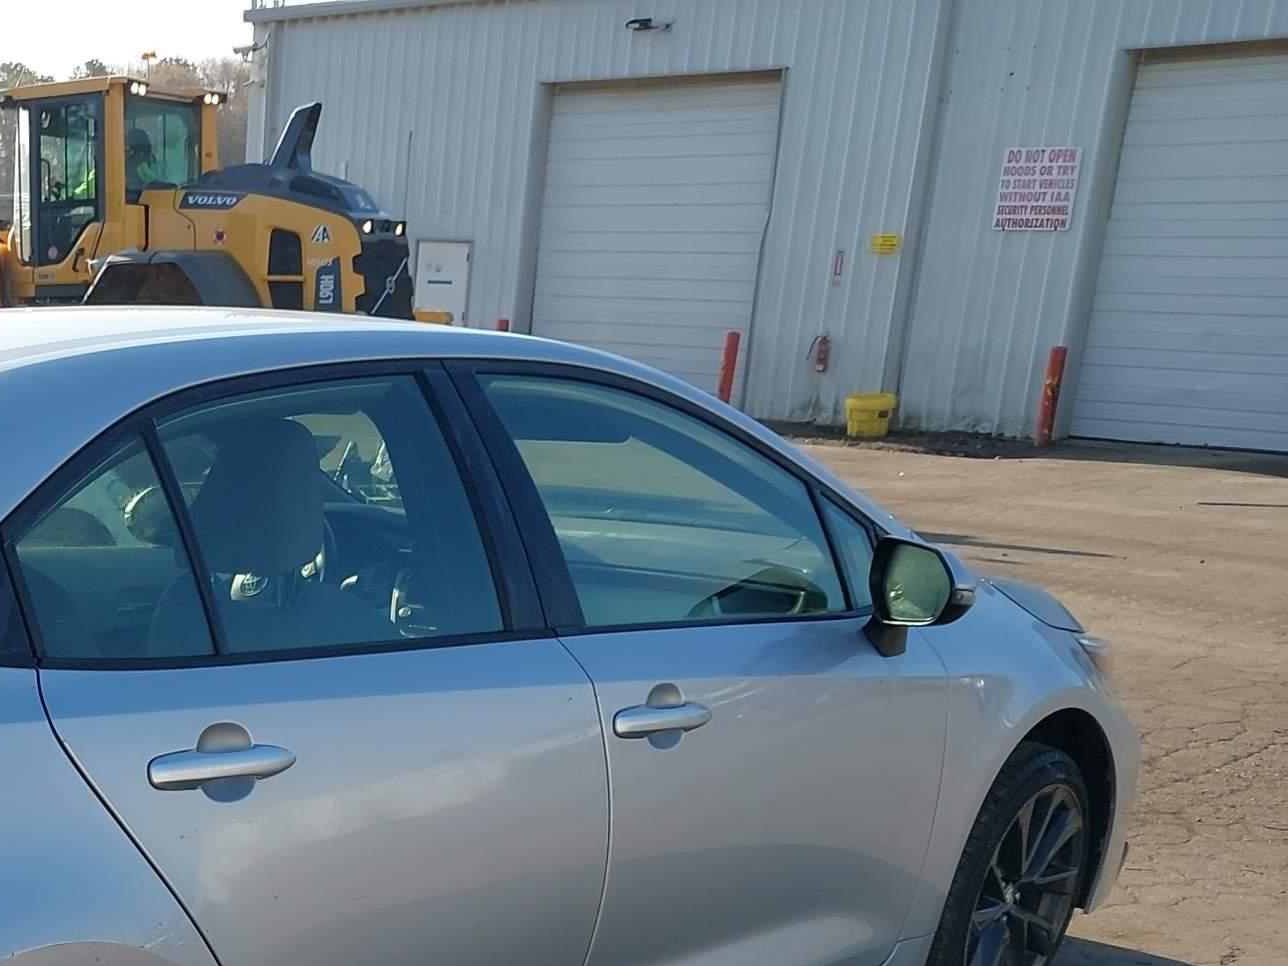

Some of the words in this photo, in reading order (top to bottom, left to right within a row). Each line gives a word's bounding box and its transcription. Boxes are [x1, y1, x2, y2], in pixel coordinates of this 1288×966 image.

[1007, 149, 1022, 163] DO
[1024, 149, 1046, 163] NOT
[1048, 148, 1077, 163] OPEN
[1003, 165, 1037, 176] HOODS
[1039, 165, 1054, 176] OR
[1056, 165, 1077, 176] TRY
[1001, 179, 1011, 190] TO
[1012, 179, 1037, 190] START
[1039, 178, 1075, 190] VEHICLES
[188, 195, 237, 206] VOLVO
[999, 191, 1048, 202] WITHOUT
[1050, 191, 1071, 202] IAA
[997, 204, 1028, 215] SECURITY
[1029, 204, 1069, 216] PERSONNEL
[994, 217, 1067, 229] AUTHORIZATION
[318, 274, 335, 305] L90H
